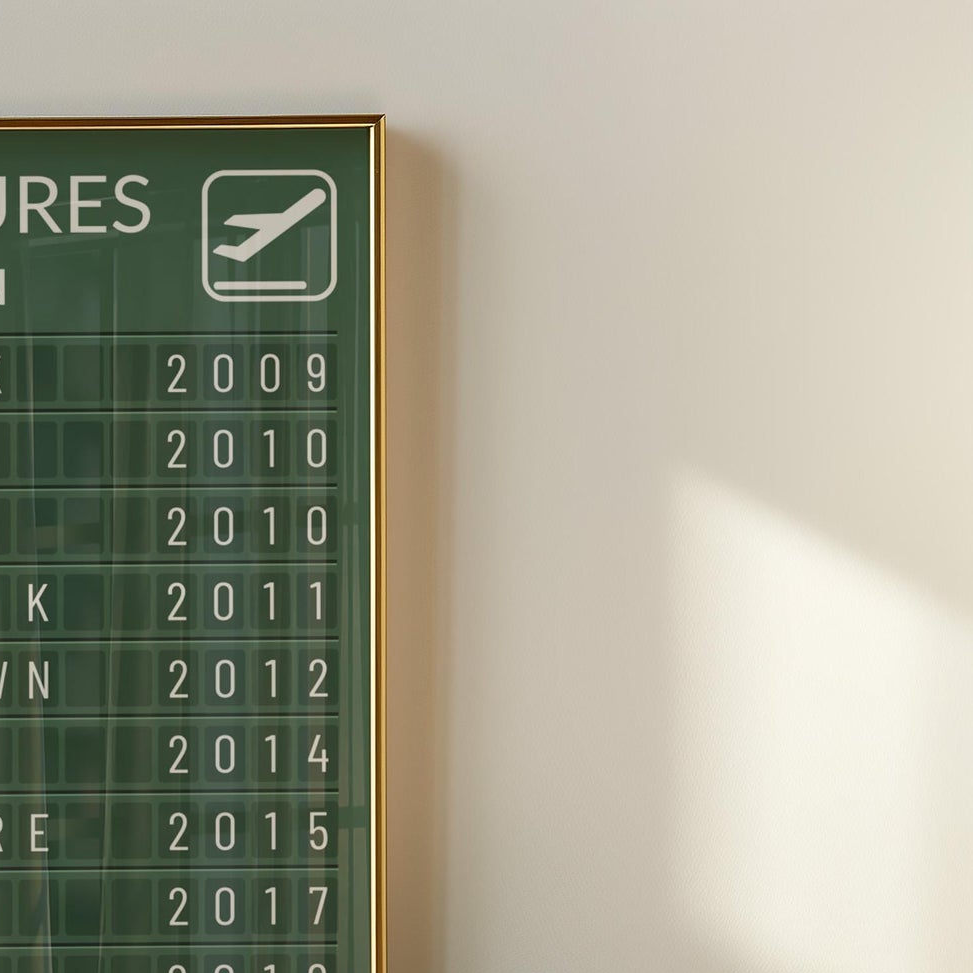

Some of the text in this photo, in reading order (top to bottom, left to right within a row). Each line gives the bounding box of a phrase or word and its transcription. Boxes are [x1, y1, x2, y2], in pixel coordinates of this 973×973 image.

[168, 353, 325, 393] 2009
[168, 429, 326, 468] 2010
[168, 506, 326, 546] 2010
[168, 582, 321, 621] 2011
[169, 659, 328, 698] 2012
[169, 735, 329, 773] 2014
[169, 812, 328, 851] 2015
[169, 887, 328, 926] 2017
